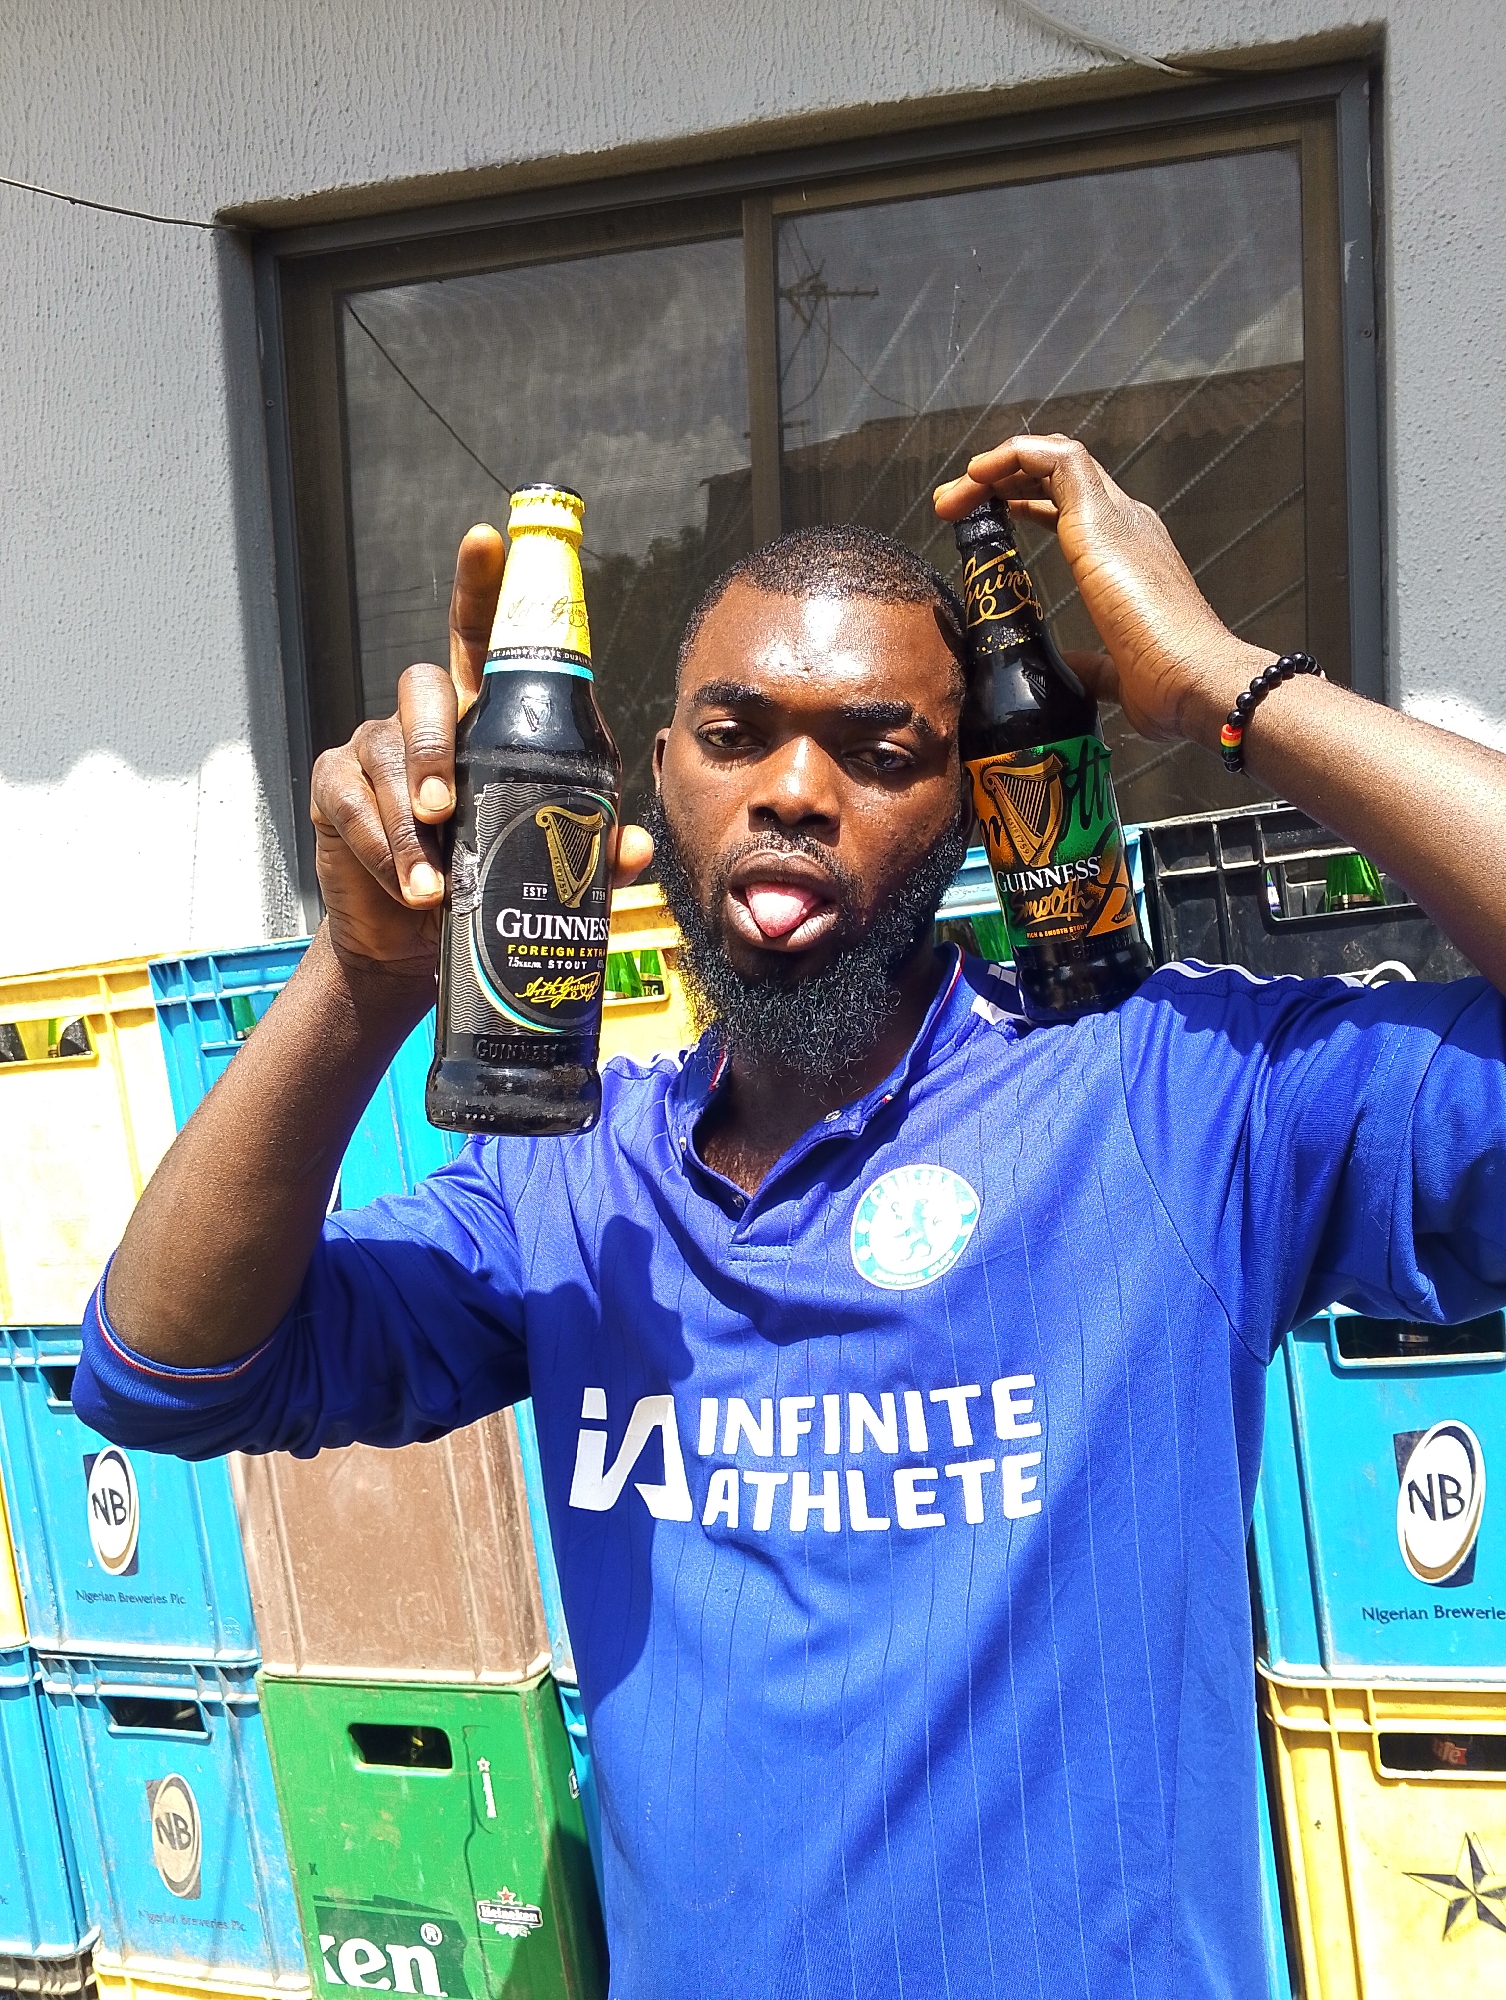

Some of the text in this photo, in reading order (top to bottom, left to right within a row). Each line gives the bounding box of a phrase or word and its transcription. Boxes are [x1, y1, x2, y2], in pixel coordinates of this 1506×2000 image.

[996, 856, 1100, 892] GUINNESS
[508, 944, 575, 957] FOREIGN
[547, 959, 588, 970] STOUT
[697, 1373, 1042, 1458] INFINITE
[91, 1487, 128, 1526] NB
[701, 1451, 1042, 1533] ATHLETE
[1407, 1472, 1466, 1521] NB
[75, 1589, 187, 1605] Nigerian Breweries Plc
[1361, 1606, 1429, 1625] Nigerian
[155, 1811, 192, 1851] NB
